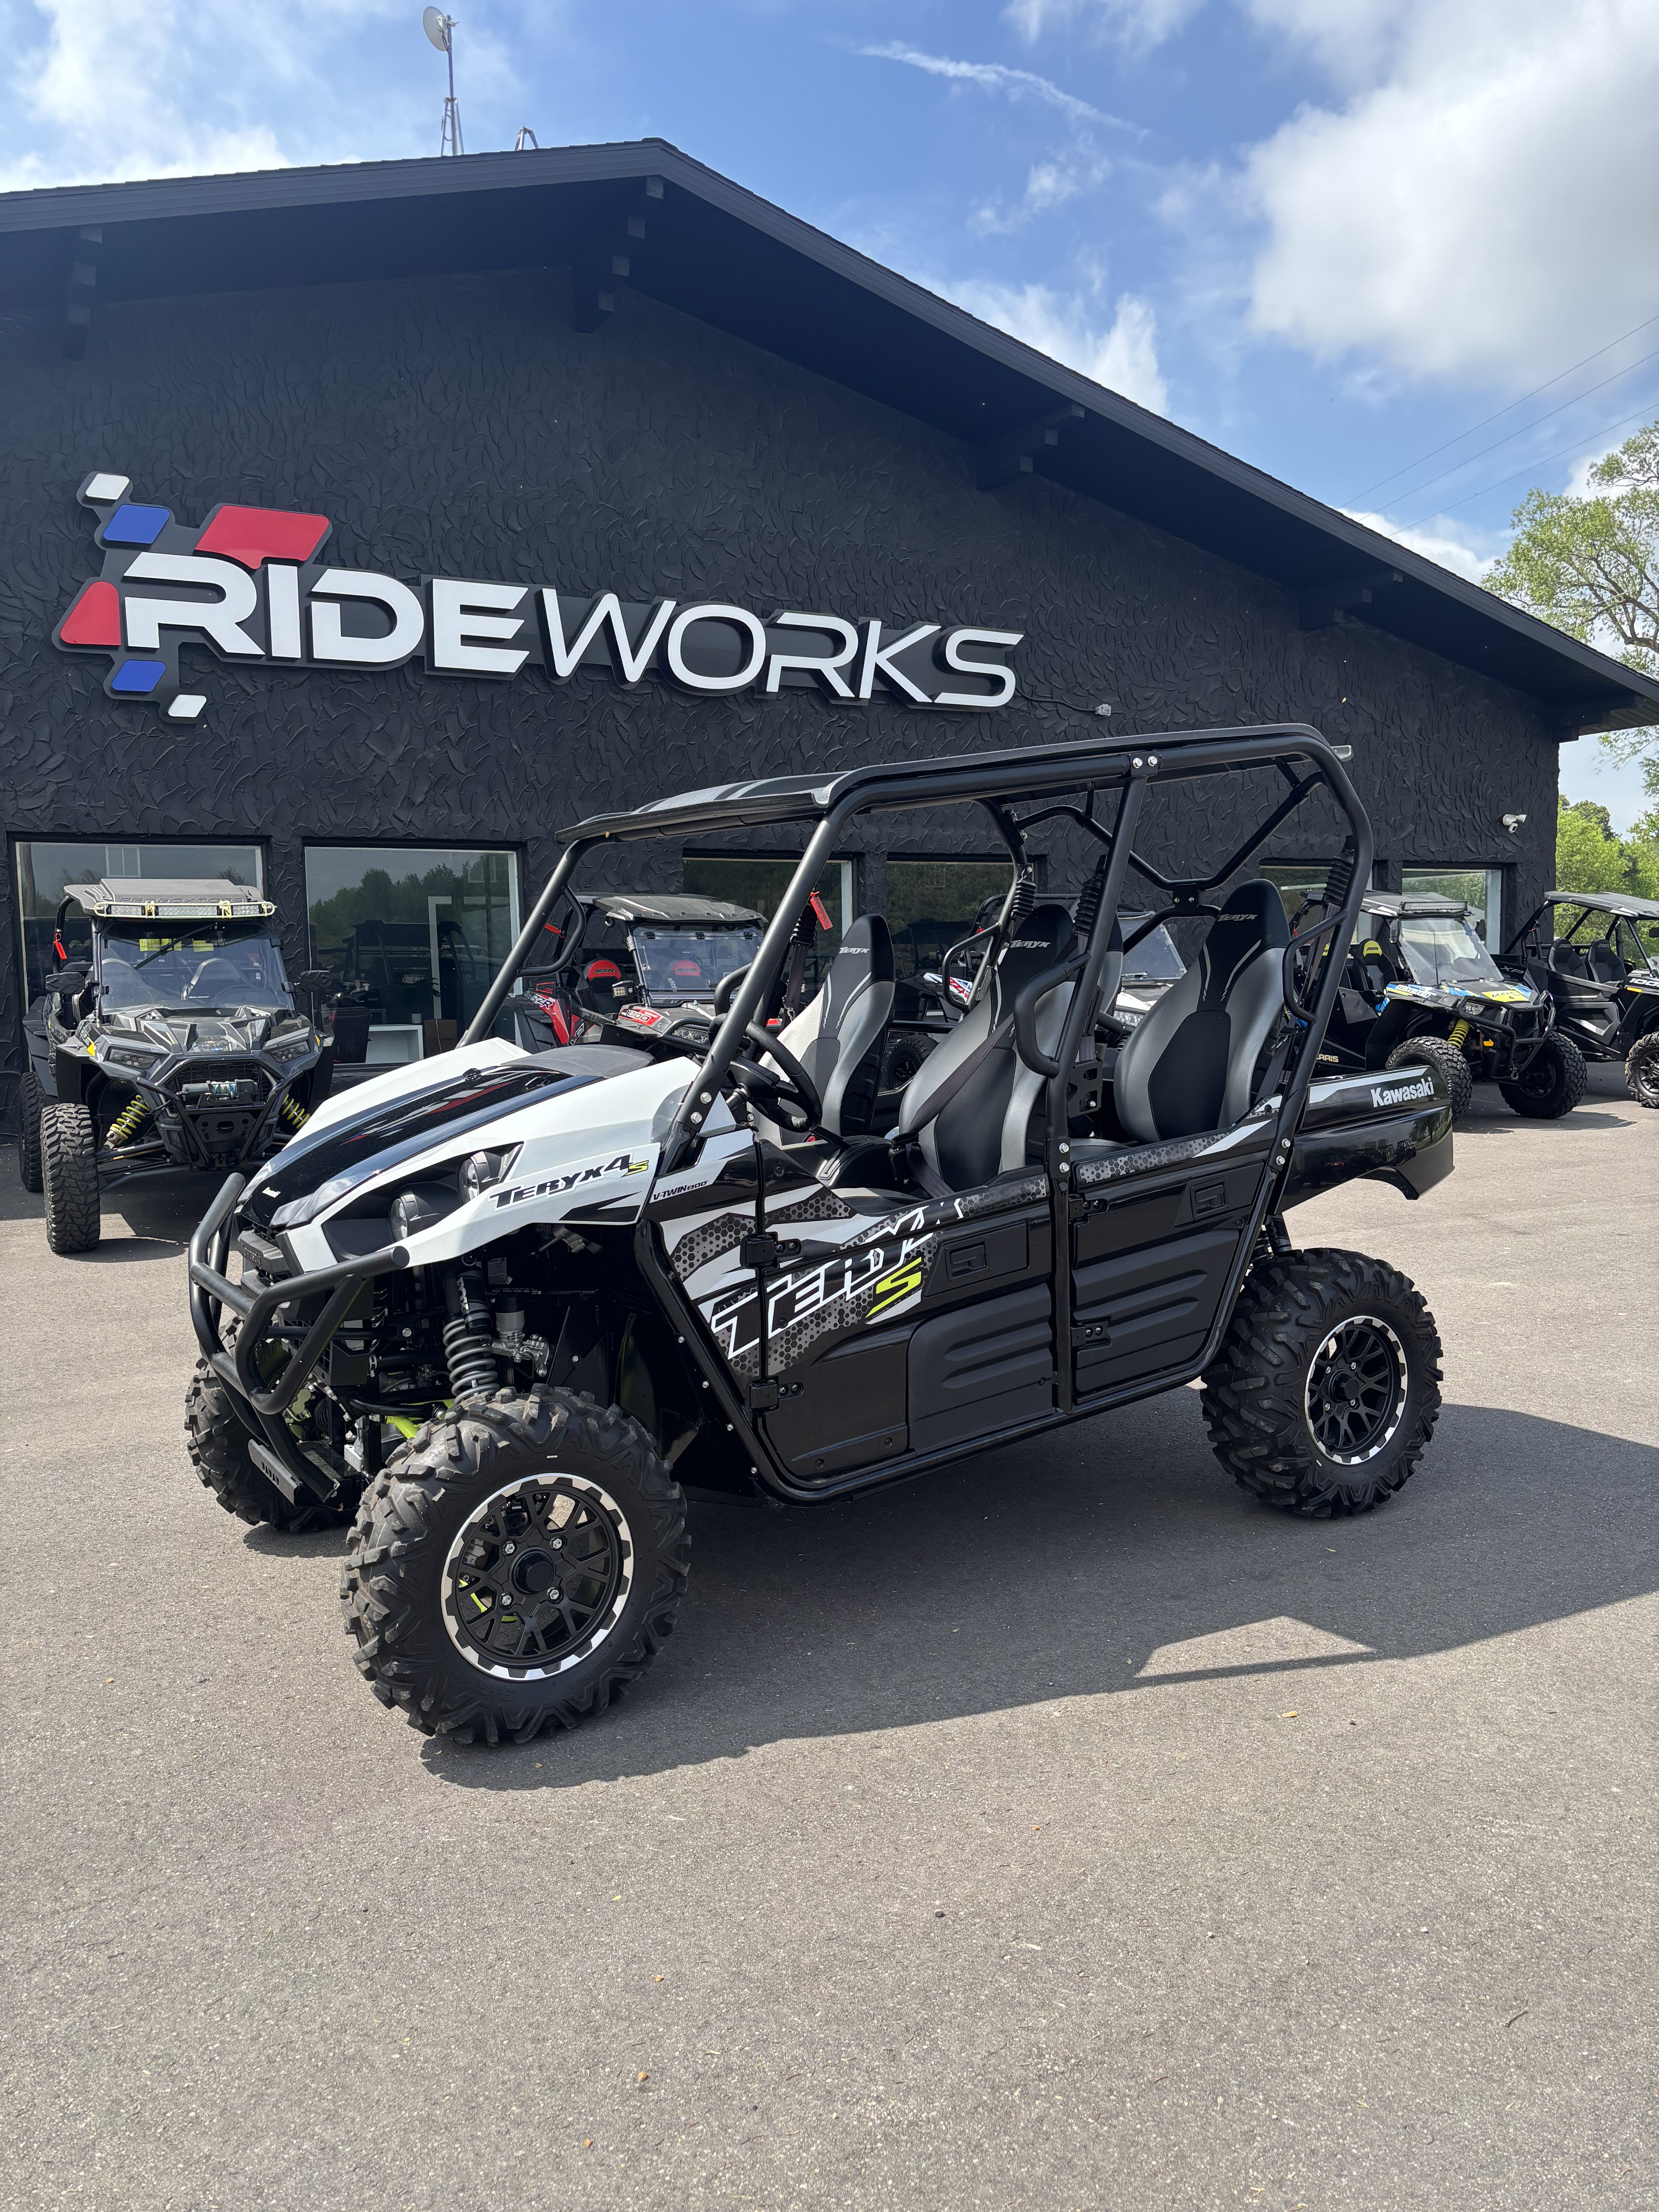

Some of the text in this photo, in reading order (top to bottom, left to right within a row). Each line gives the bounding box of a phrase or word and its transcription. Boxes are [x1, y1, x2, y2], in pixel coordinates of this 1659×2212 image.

[124, 552, 1024, 707] RIDEWORKS
[1217, 914, 1258, 922] TERYX
[1010, 939, 1051, 948] TERYX
[839, 946, 871, 954] TERYX
[1629, 978, 1659, 988] 100
[531, 994, 554, 1010] RZR
[626, 1009, 651, 1022] 1000
[1370, 1077, 1434, 1108] Kawasaki
